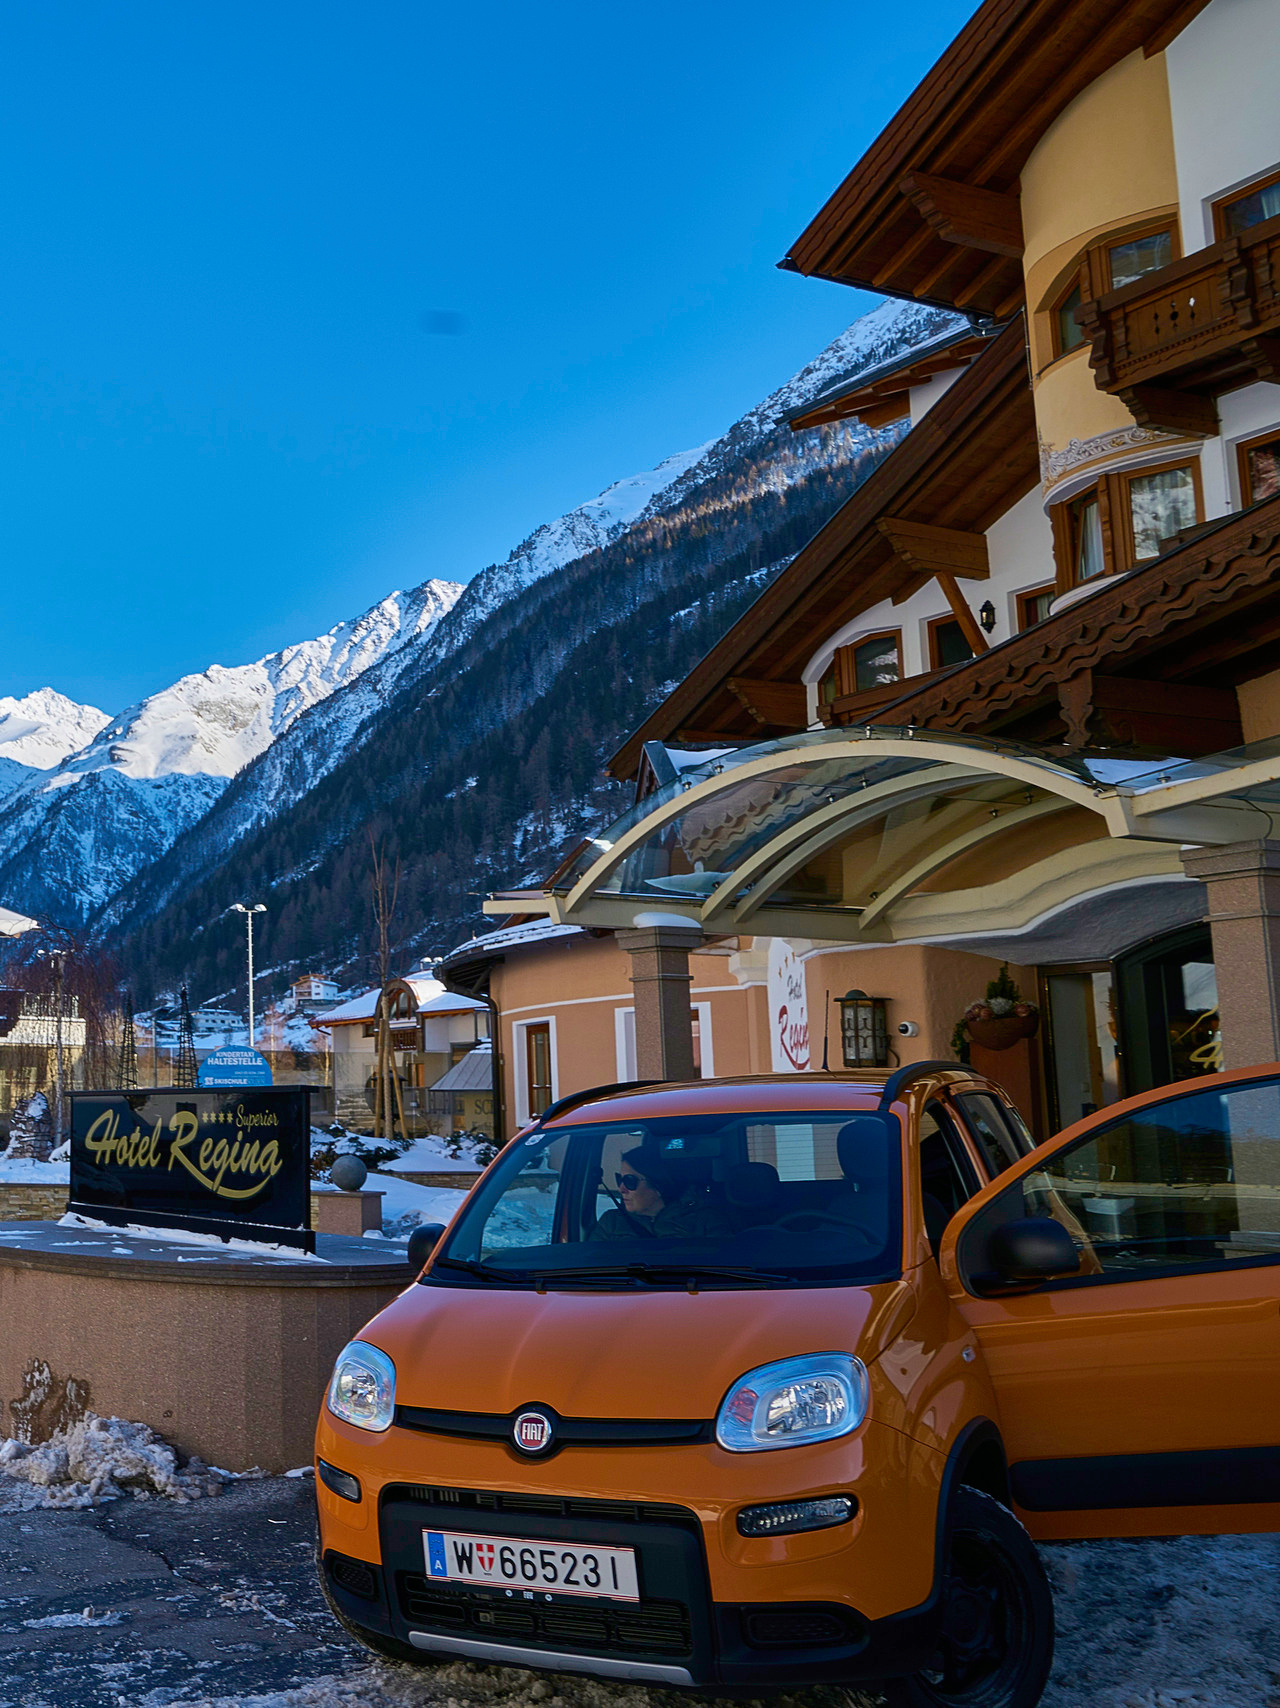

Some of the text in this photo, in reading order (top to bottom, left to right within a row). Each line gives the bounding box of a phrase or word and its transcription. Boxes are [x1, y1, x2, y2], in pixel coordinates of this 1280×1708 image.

[207, 1057, 263, 1066] HALTESTELLE
[236, 1104, 279, 1132] Superior
[85, 1108, 283, 1199] Hotel Regina
[522, 1422, 544, 1441] FIAT
[434, 1559, 443, 1571] A
